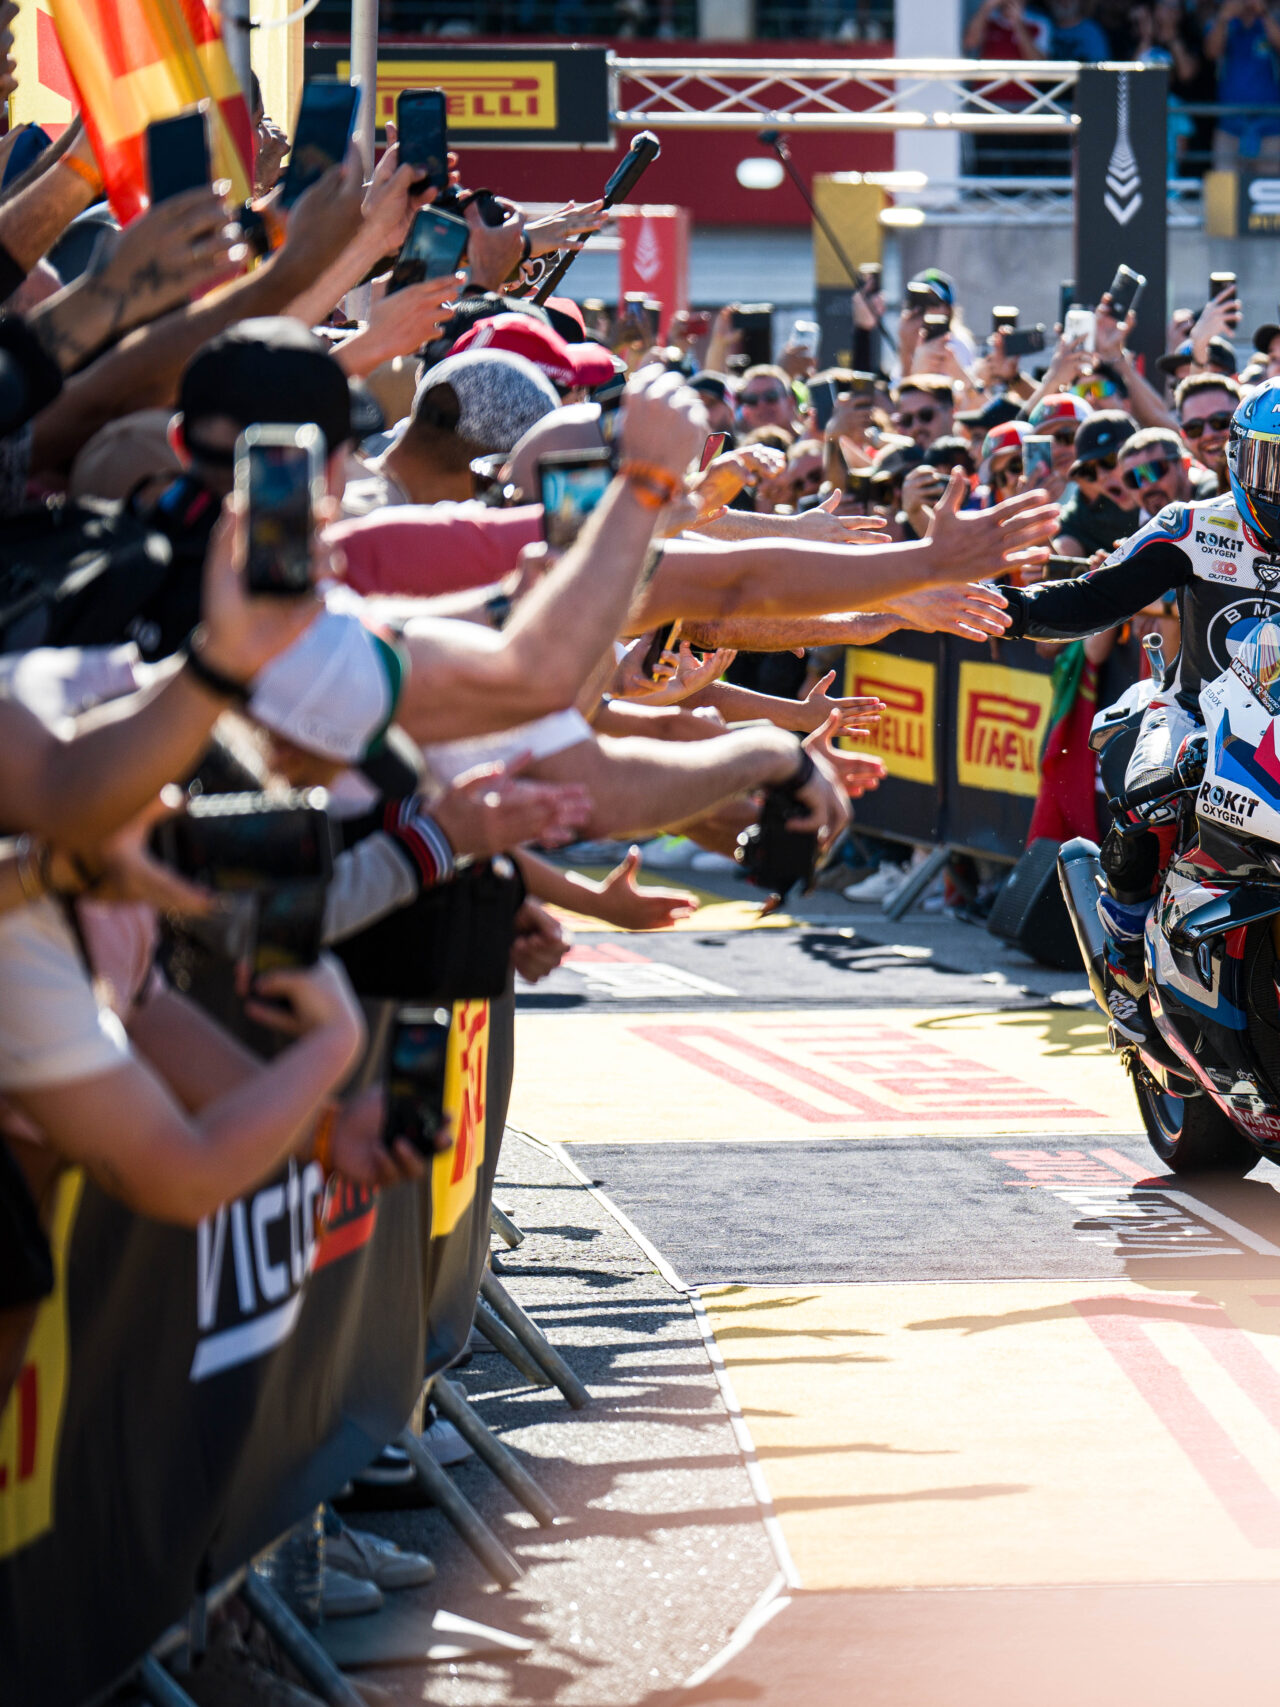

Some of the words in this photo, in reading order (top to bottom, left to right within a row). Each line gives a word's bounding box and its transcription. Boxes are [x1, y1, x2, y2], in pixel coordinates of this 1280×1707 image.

[365, 76, 539, 116] PIELLI
[1201, 546, 1237, 559] OXYGEN
[1208, 573, 1238, 583] OUTDO
[1230, 658, 1257, 690] WRS
[1205, 688, 1222, 707] EDOX
[1202, 804, 1245, 827] OXYGEN
[625, 1025, 1110, 1123] PIRELLI
